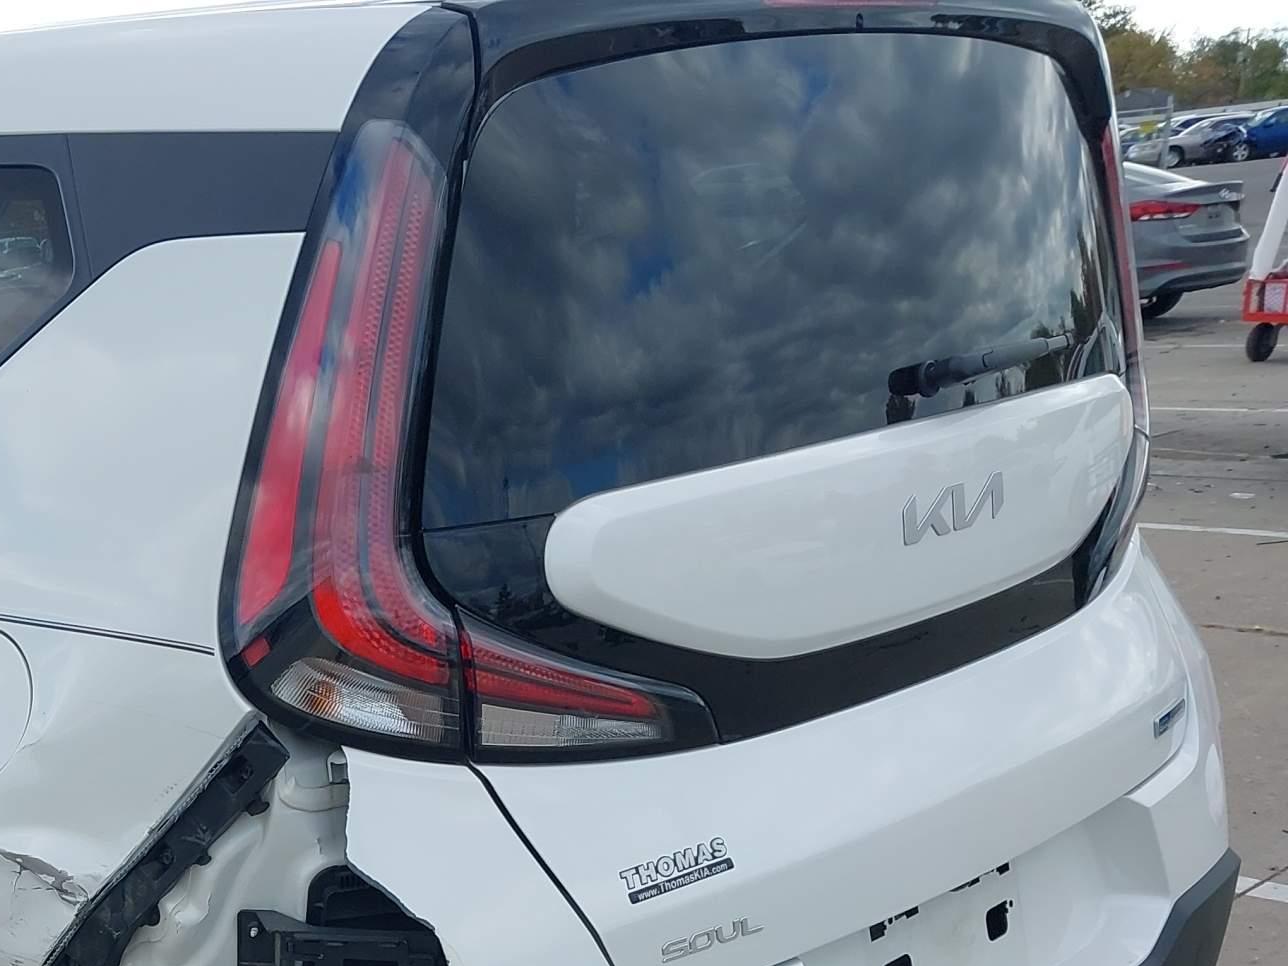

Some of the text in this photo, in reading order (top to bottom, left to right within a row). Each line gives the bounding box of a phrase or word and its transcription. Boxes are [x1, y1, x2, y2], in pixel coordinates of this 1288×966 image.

[619, 837, 728, 890] THOMAS
[636, 861, 729, 902] www.ThomasKIA.com
[661, 917, 765, 964] SOUL
